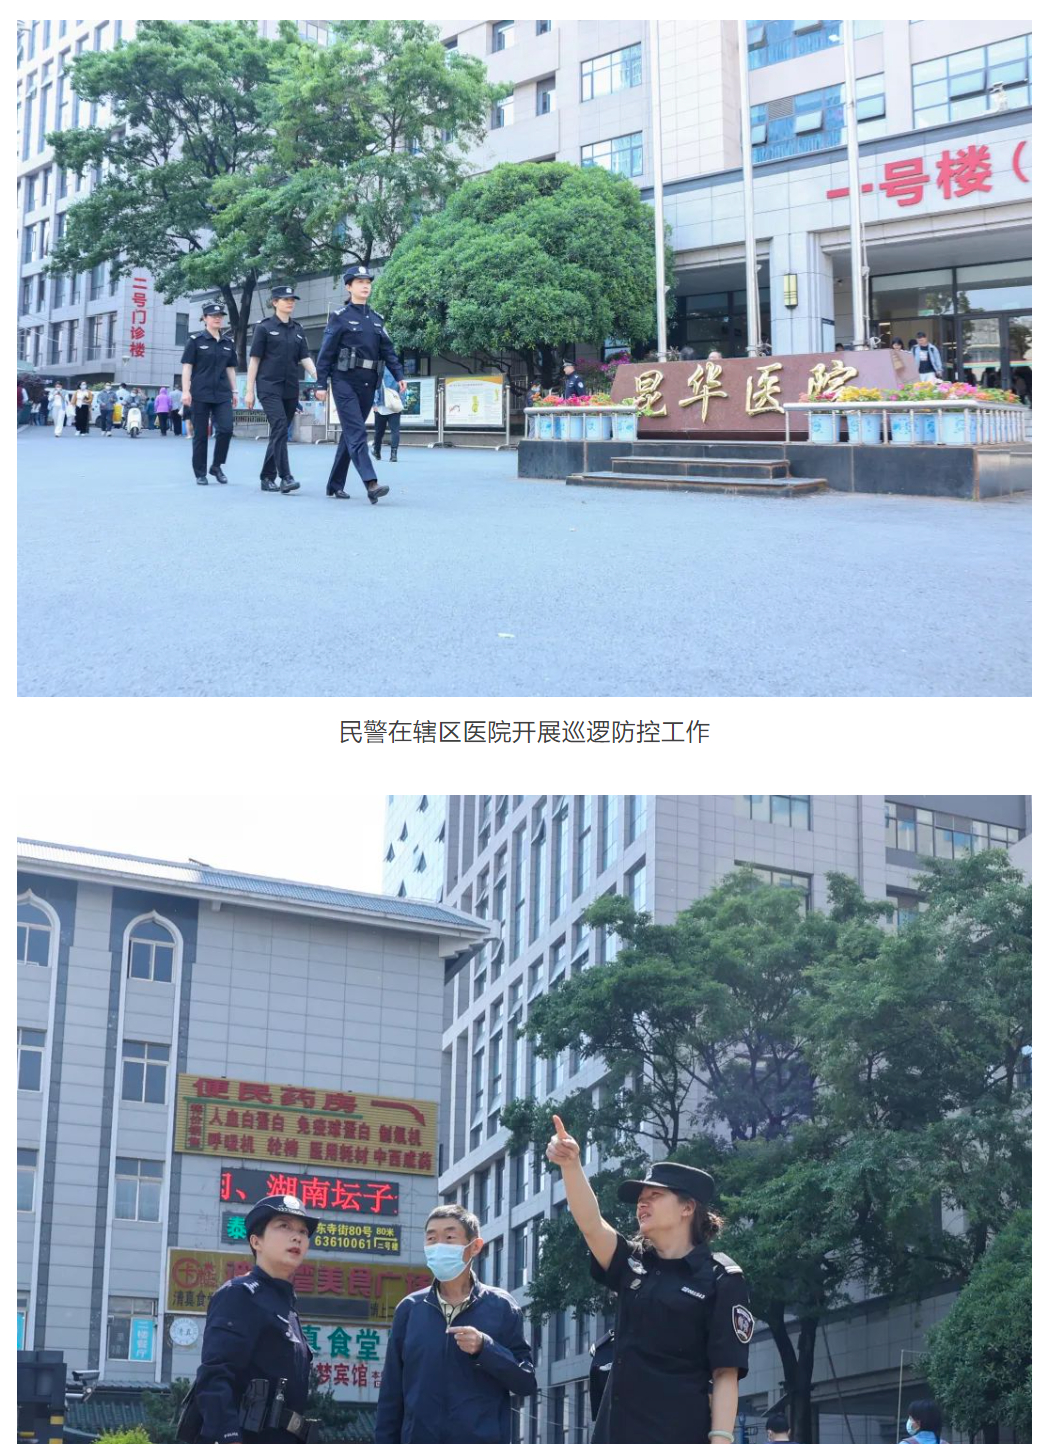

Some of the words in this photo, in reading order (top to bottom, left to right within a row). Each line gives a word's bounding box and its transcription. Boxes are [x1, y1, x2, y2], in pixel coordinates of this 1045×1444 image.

[130, 277, 147, 358] 二号门诊楼
[632, 360, 859, 424] 昆华医院
[193, 1077, 358, 1114] 便民药房
[209, 1107, 285, 1133] 人血白蛋白
[314, 1236, 371, 1250] 63610061
[316, 1222, 373, 1238] 东寺街80号
[173, 1290, 213, 1307] 清真食
